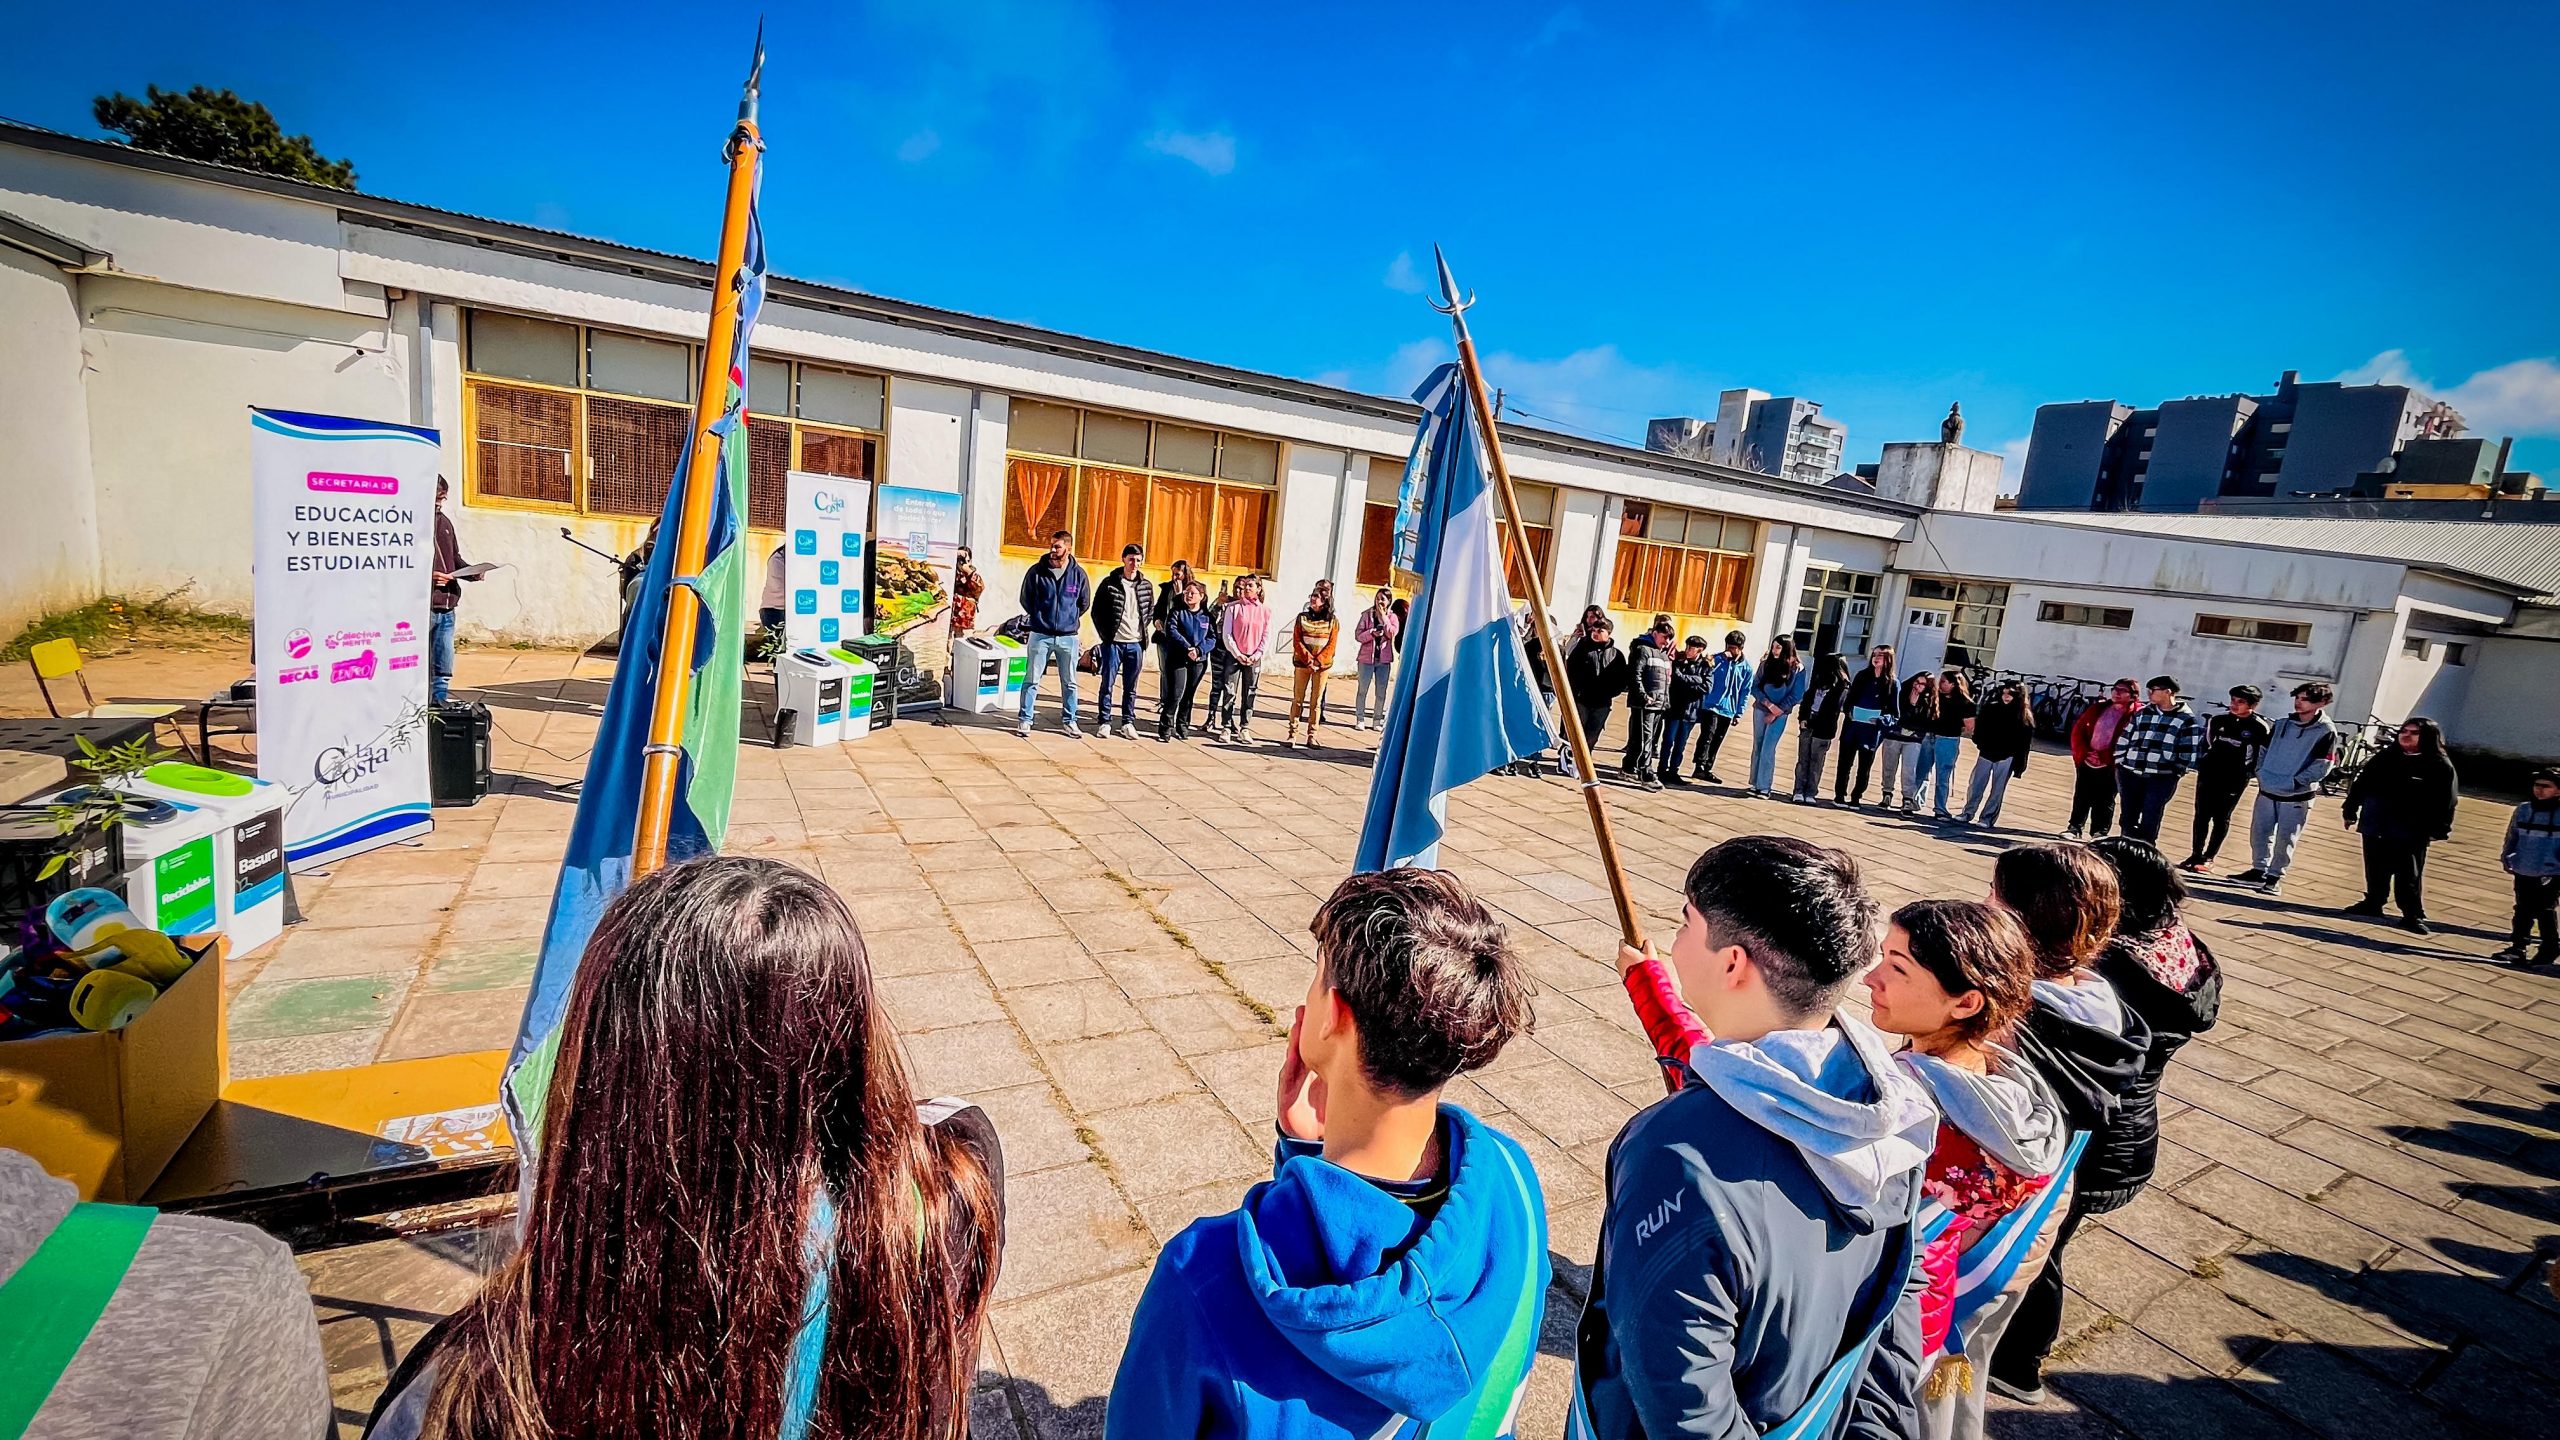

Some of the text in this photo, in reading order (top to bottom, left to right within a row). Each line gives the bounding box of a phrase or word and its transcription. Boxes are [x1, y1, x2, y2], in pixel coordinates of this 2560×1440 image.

[381, 480, 395, 490] DE
[295, 505, 413, 523] EDUCACIÓN
[287, 531, 414, 546] Y BIENESTAR
[288, 555, 415, 571] ESTUDIANTIL
[279, 670, 319, 684] BECAS
[314, 744, 389, 784] La Costa
[239, 848, 278, 874] Basura
[1635, 1187, 1686, 1247] RUN
